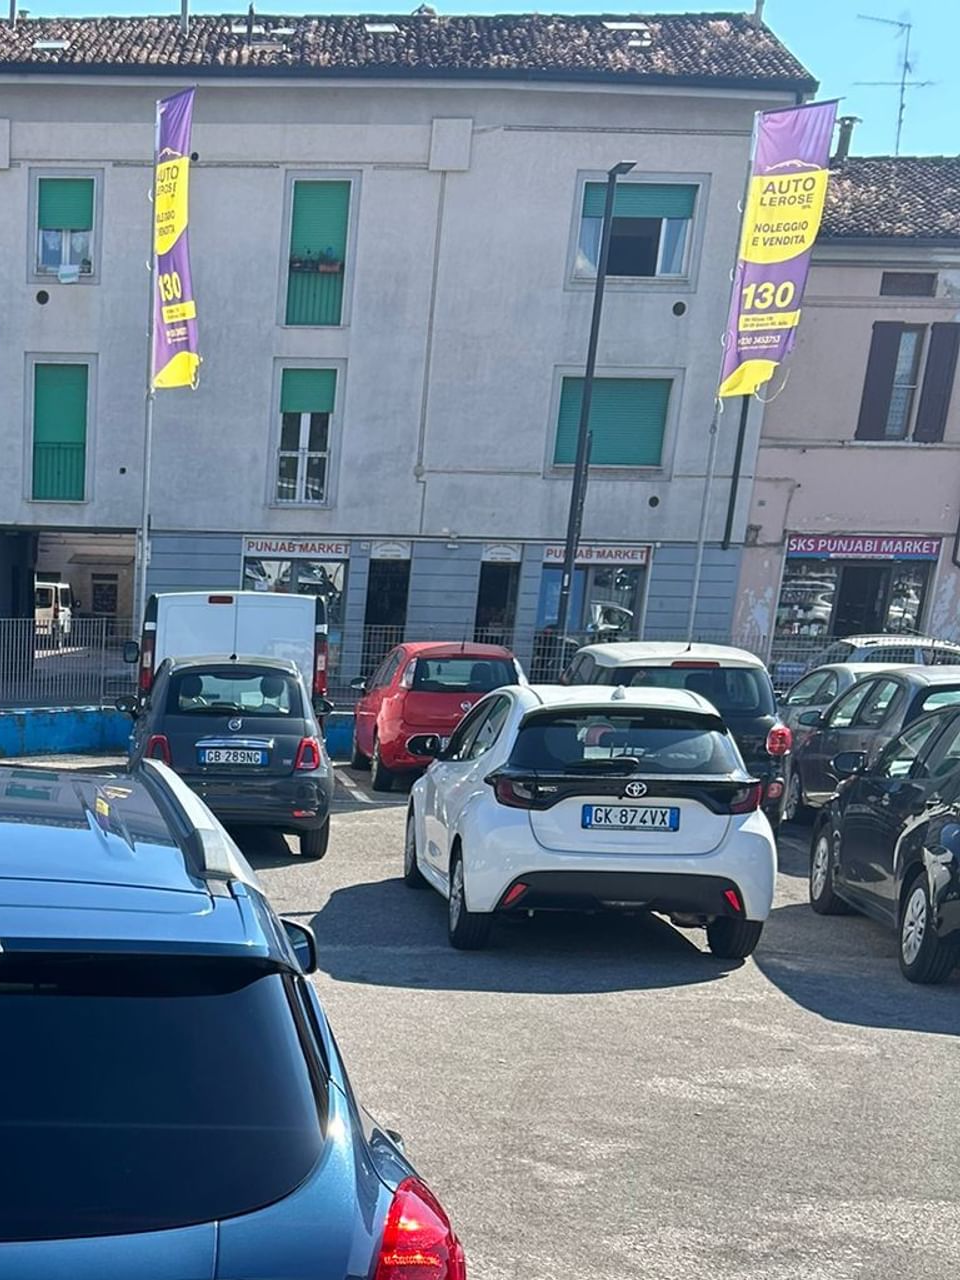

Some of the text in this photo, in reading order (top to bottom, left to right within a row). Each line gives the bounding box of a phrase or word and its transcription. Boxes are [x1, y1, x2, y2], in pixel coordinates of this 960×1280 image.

[762, 177, 816, 195] AUTO
[759, 193, 814, 207] LEROSE
[754, 220, 809, 233] NOLEGGIO
[752, 235, 805, 246] E VENDITA
[159, 271, 182, 302] 130
[742, 281, 795, 310] 130
[247, 541, 351, 554] PUNJAB MARKET
[789, 538, 940, 553] SKS PUNJABI MARKET
[546, 548, 646, 560] PUAB MARKET
[594, 808, 669, 825] GK 874VX
